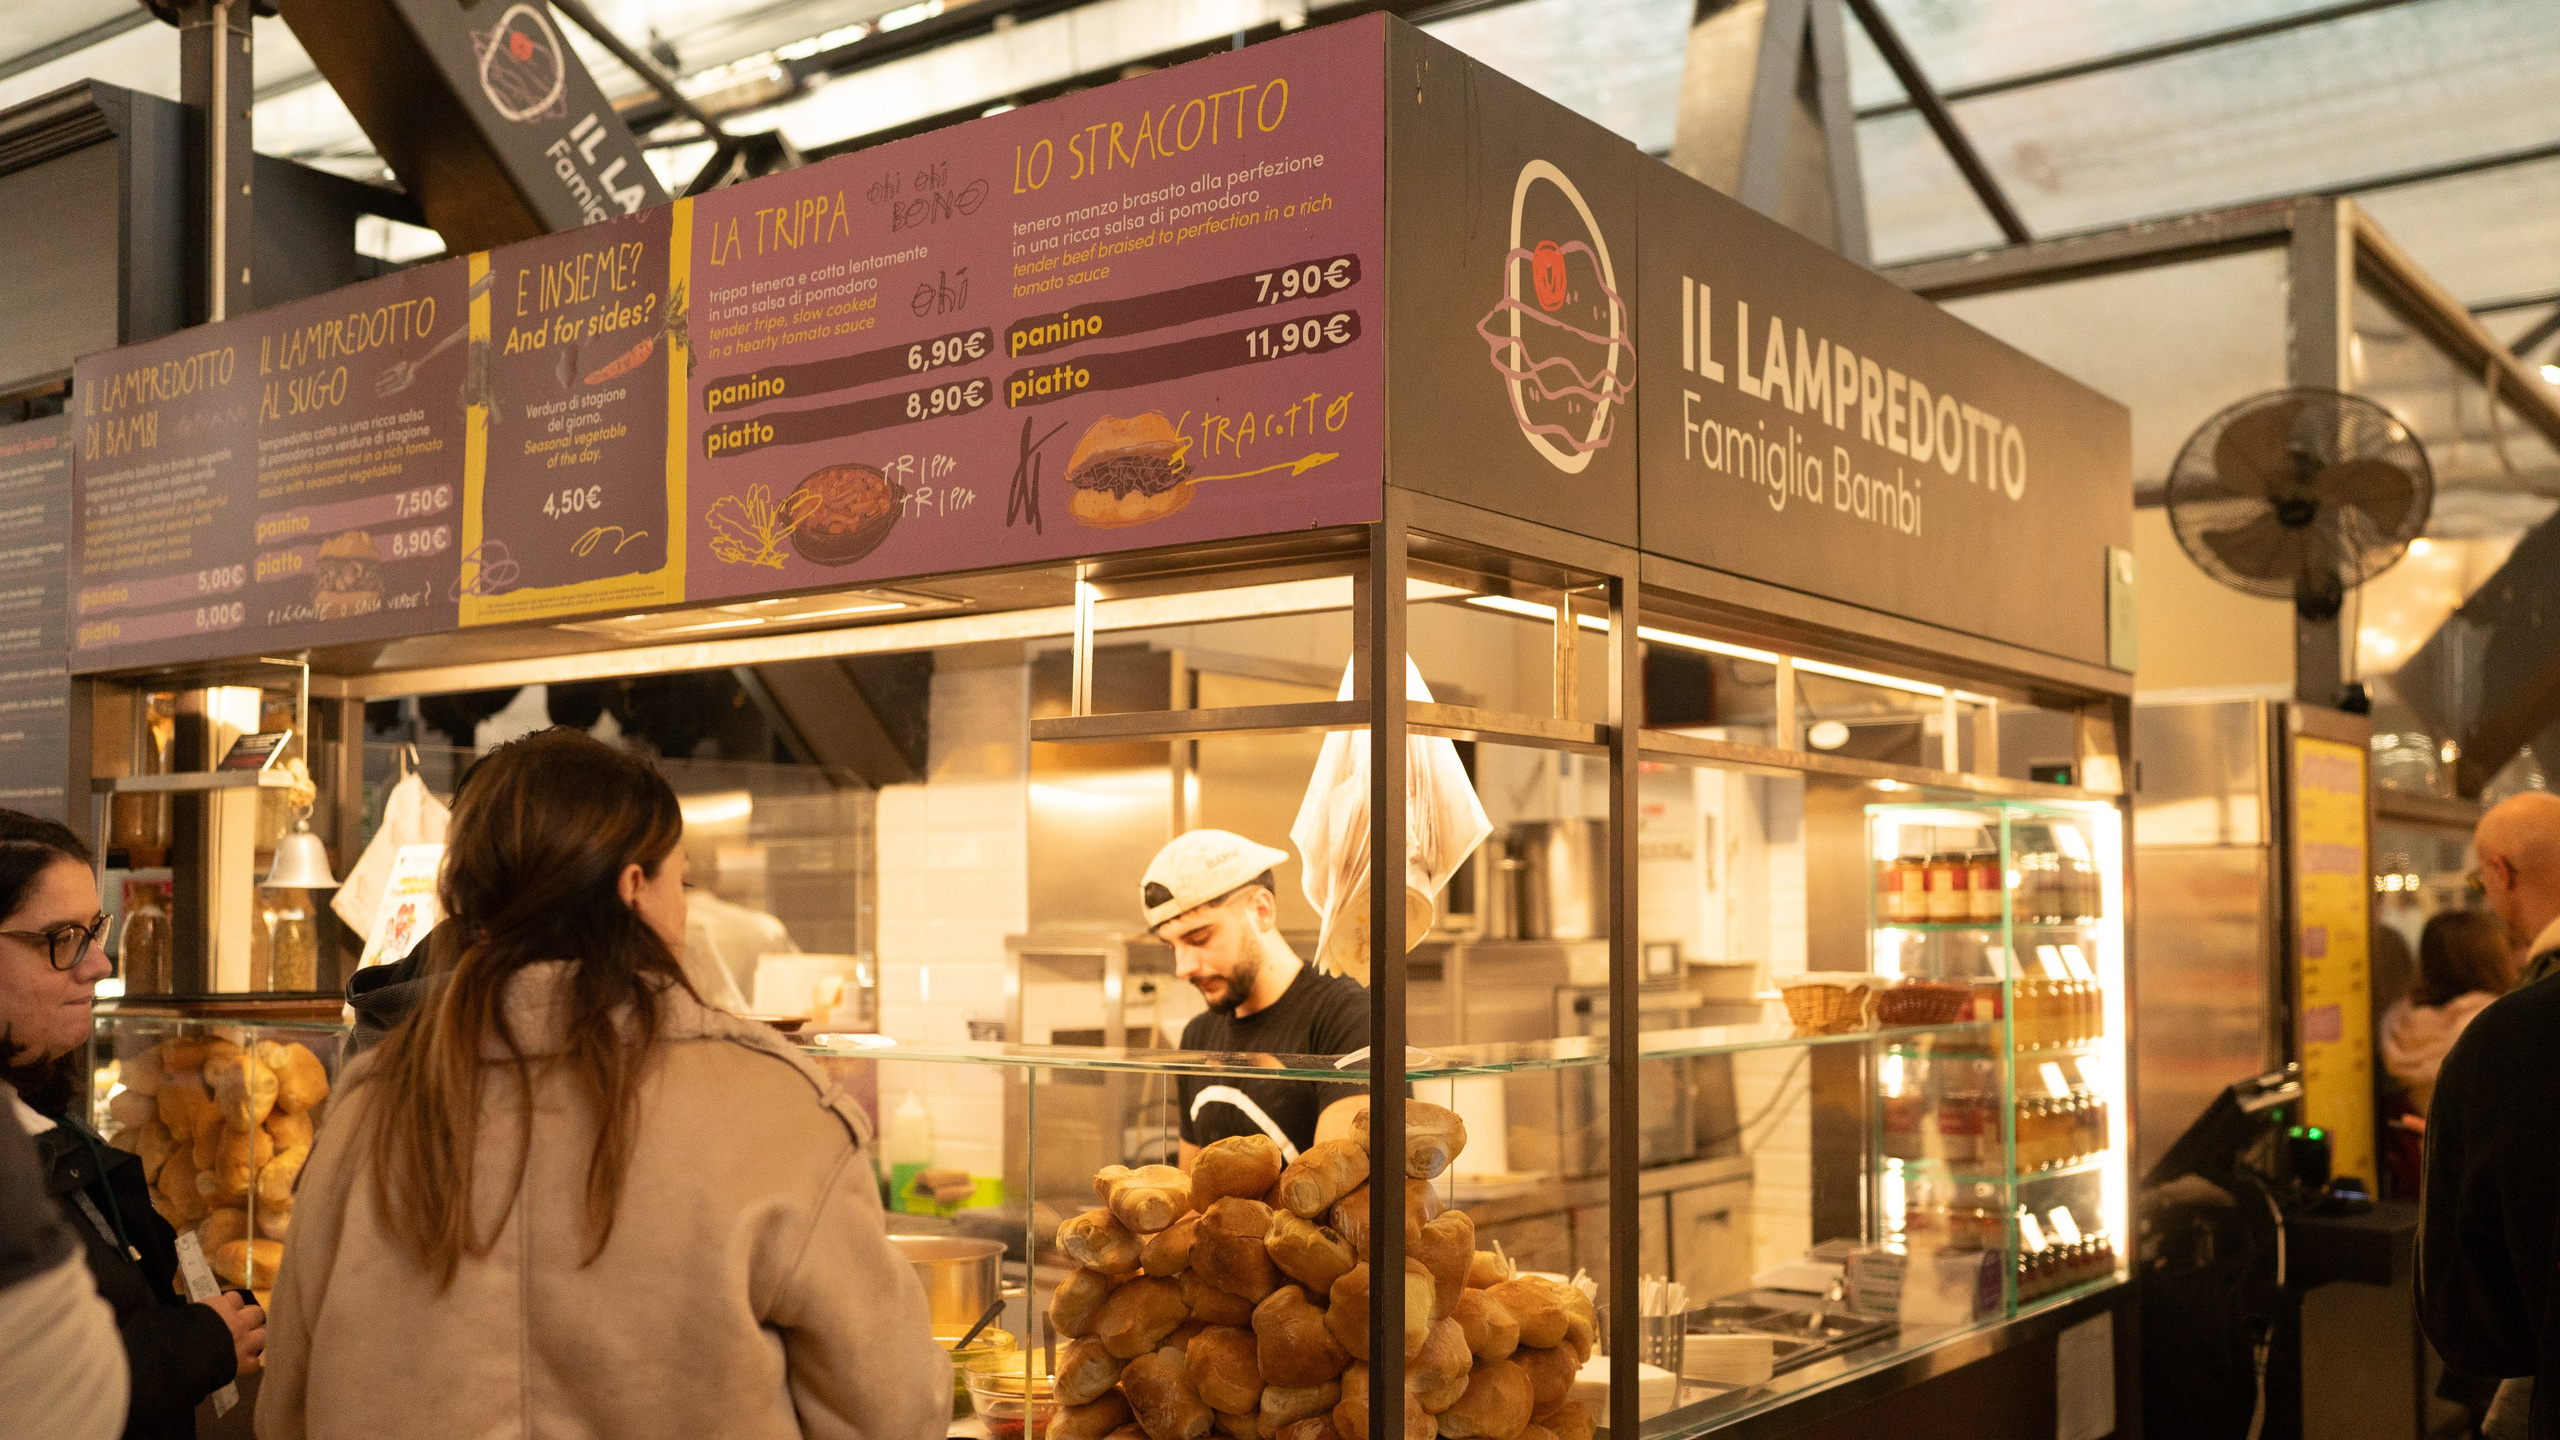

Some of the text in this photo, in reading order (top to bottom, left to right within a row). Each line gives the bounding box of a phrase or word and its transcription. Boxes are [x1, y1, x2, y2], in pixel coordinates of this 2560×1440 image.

[569, 112, 607, 166] IL
[1013, 78, 1288, 194] LO STRACOTTO
[1013, 154, 1324, 236] tenero manzo brasato alla perfezione
[1013, 190, 1260, 257] in una ricca salsa di pomodoro
[710, 191, 850, 266] LA TRIPPA
[1013, 192, 1333, 277] tender beef braised to perfection in a rich
[517, 241, 643, 317] E INSIEME?
[709, 245, 928, 304] trippa tenera e cotta lentamente
[709, 277, 877, 322] in una salsa di pomodoro
[1013, 266, 1110, 299] tomato sauce
[260, 296, 435, 375] IL LAMPREDOTTO
[503, 293, 656, 356] And for sides?
[709, 293, 878, 341] tender tripe, slow cooked
[1012, 259, 1351, 358] panino 7,90€
[709, 317, 875, 360] in a hearty tomato sauce
[1011, 314, 1351, 407] piatto 11,90€
[102, 347, 234, 412] LAMPREDOTTO
[259, 381, 280, 425] AL
[289, 366, 347, 415] SUGO
[708, 331, 985, 414] panino 6,90€
[1682, 275, 2026, 501] IL LAMPREDOTTO
[350, 420, 369, 433] una
[371, 414, 396, 429] ricca
[398, 408, 424, 424] salsa
[526, 388, 626, 419] Verdura di stagione
[548, 416, 564, 433] del
[708, 380, 985, 459] piatto 8,90€
[374, 430, 384, 445] di
[386, 425, 430, 445] stagione
[405, 437, 443, 456] tomato
[524, 422, 627, 455] Seasonal vegetable
[547, 454, 558, 469] of
[560, 452, 577, 466] the
[1683, 389, 1921, 537] Famiglia Bambi
[257, 512, 310, 545] panino
[395, 485, 448, 518] 7,50€
[543, 485, 602, 520] 4,50€
[198, 564, 244, 593] 5,00€
[256, 527, 446, 582] piatto 8,90€
